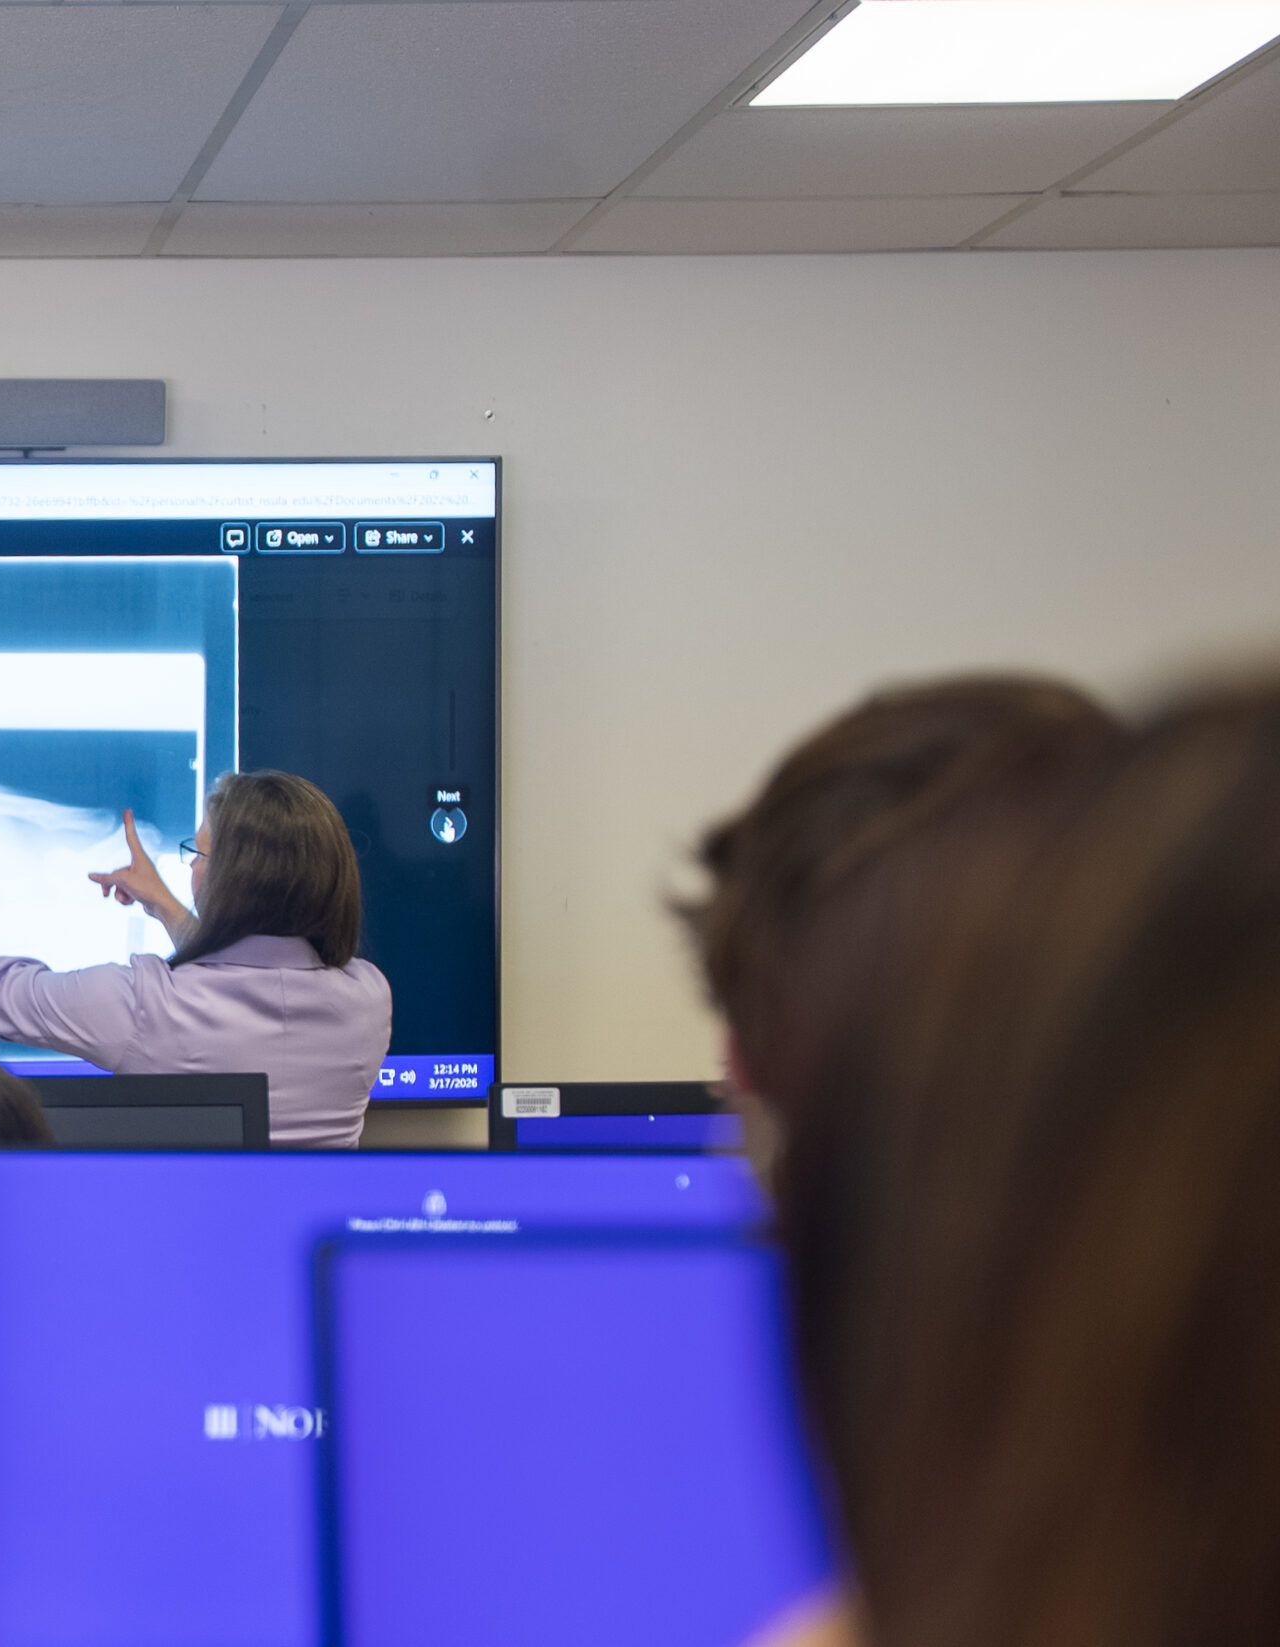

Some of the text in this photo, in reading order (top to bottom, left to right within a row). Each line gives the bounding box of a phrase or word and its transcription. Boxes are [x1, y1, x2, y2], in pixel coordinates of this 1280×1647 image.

[287, 530, 319, 547] Open
[386, 530, 419, 545] Share
[436, 790, 461, 802] Next
[433, 1063, 477, 1075] 12:14 PM
[429, 1078, 477, 1089] 3/17/2026
